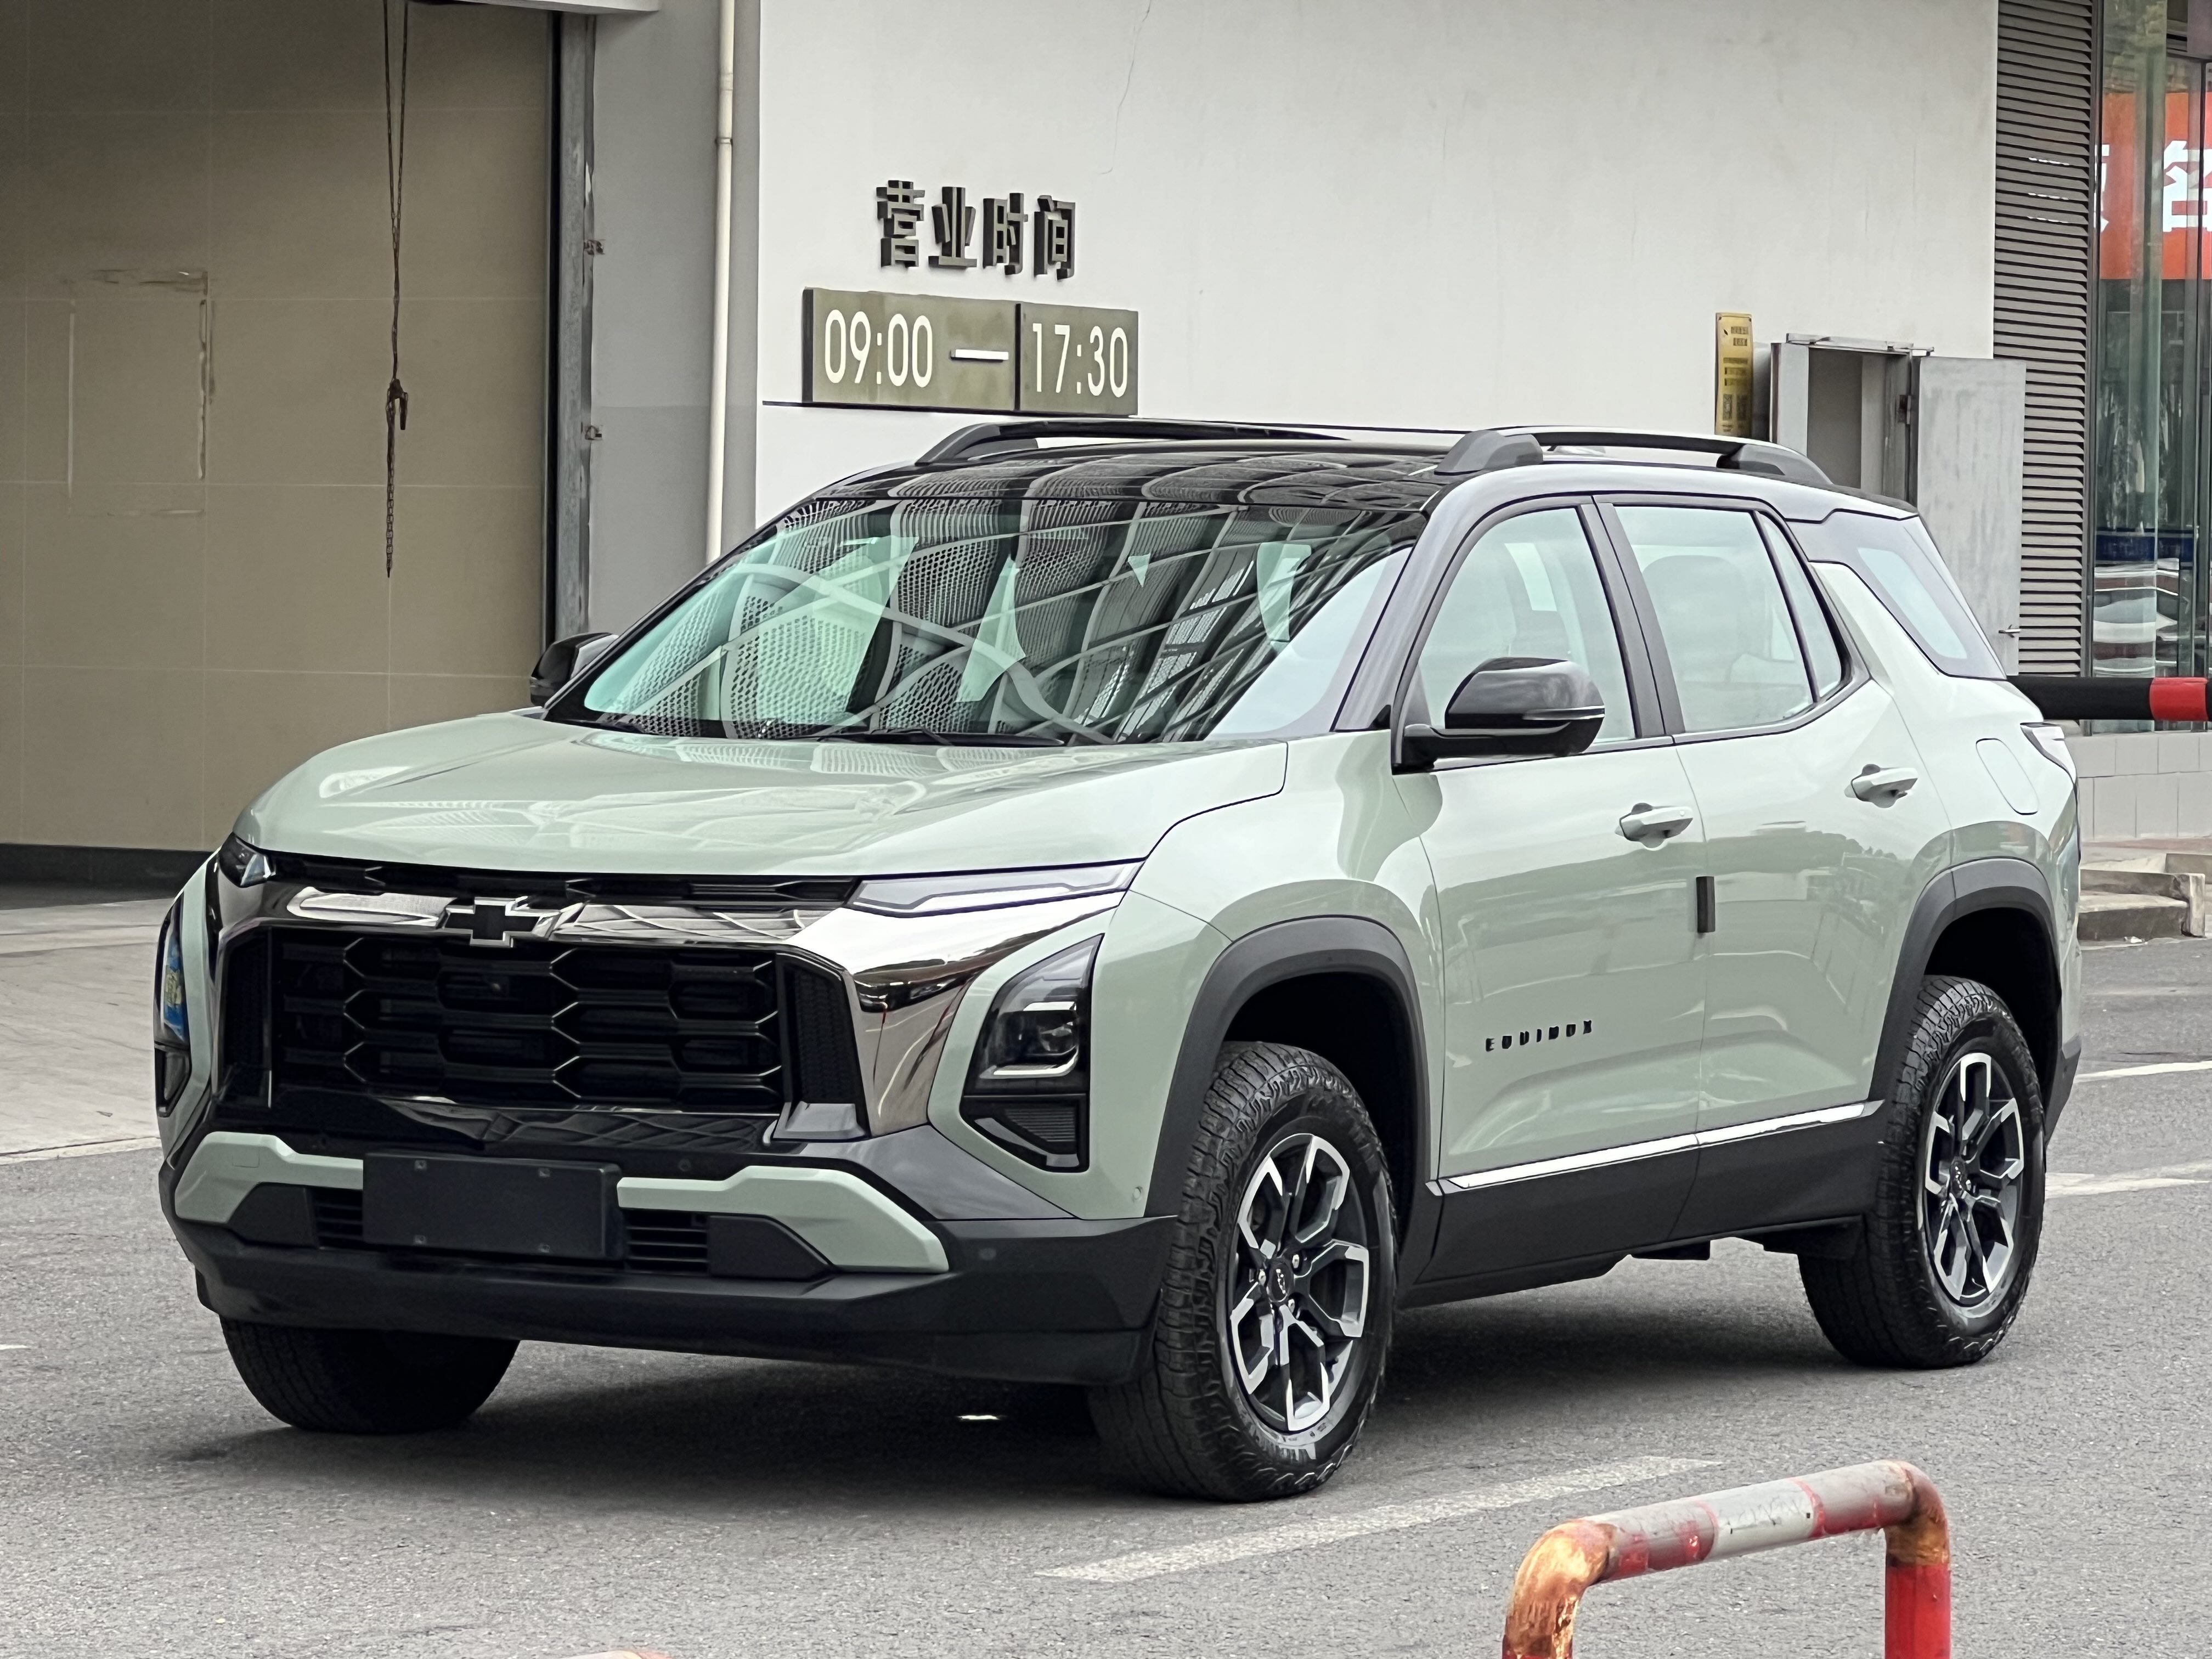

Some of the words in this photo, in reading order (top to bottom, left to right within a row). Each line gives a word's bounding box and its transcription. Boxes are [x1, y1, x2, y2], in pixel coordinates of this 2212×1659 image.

[876, 179, 1076, 280] 营业时间
[825, 309, 933, 388] 09:00
[1032, 322, 1128, 398] 17:30
